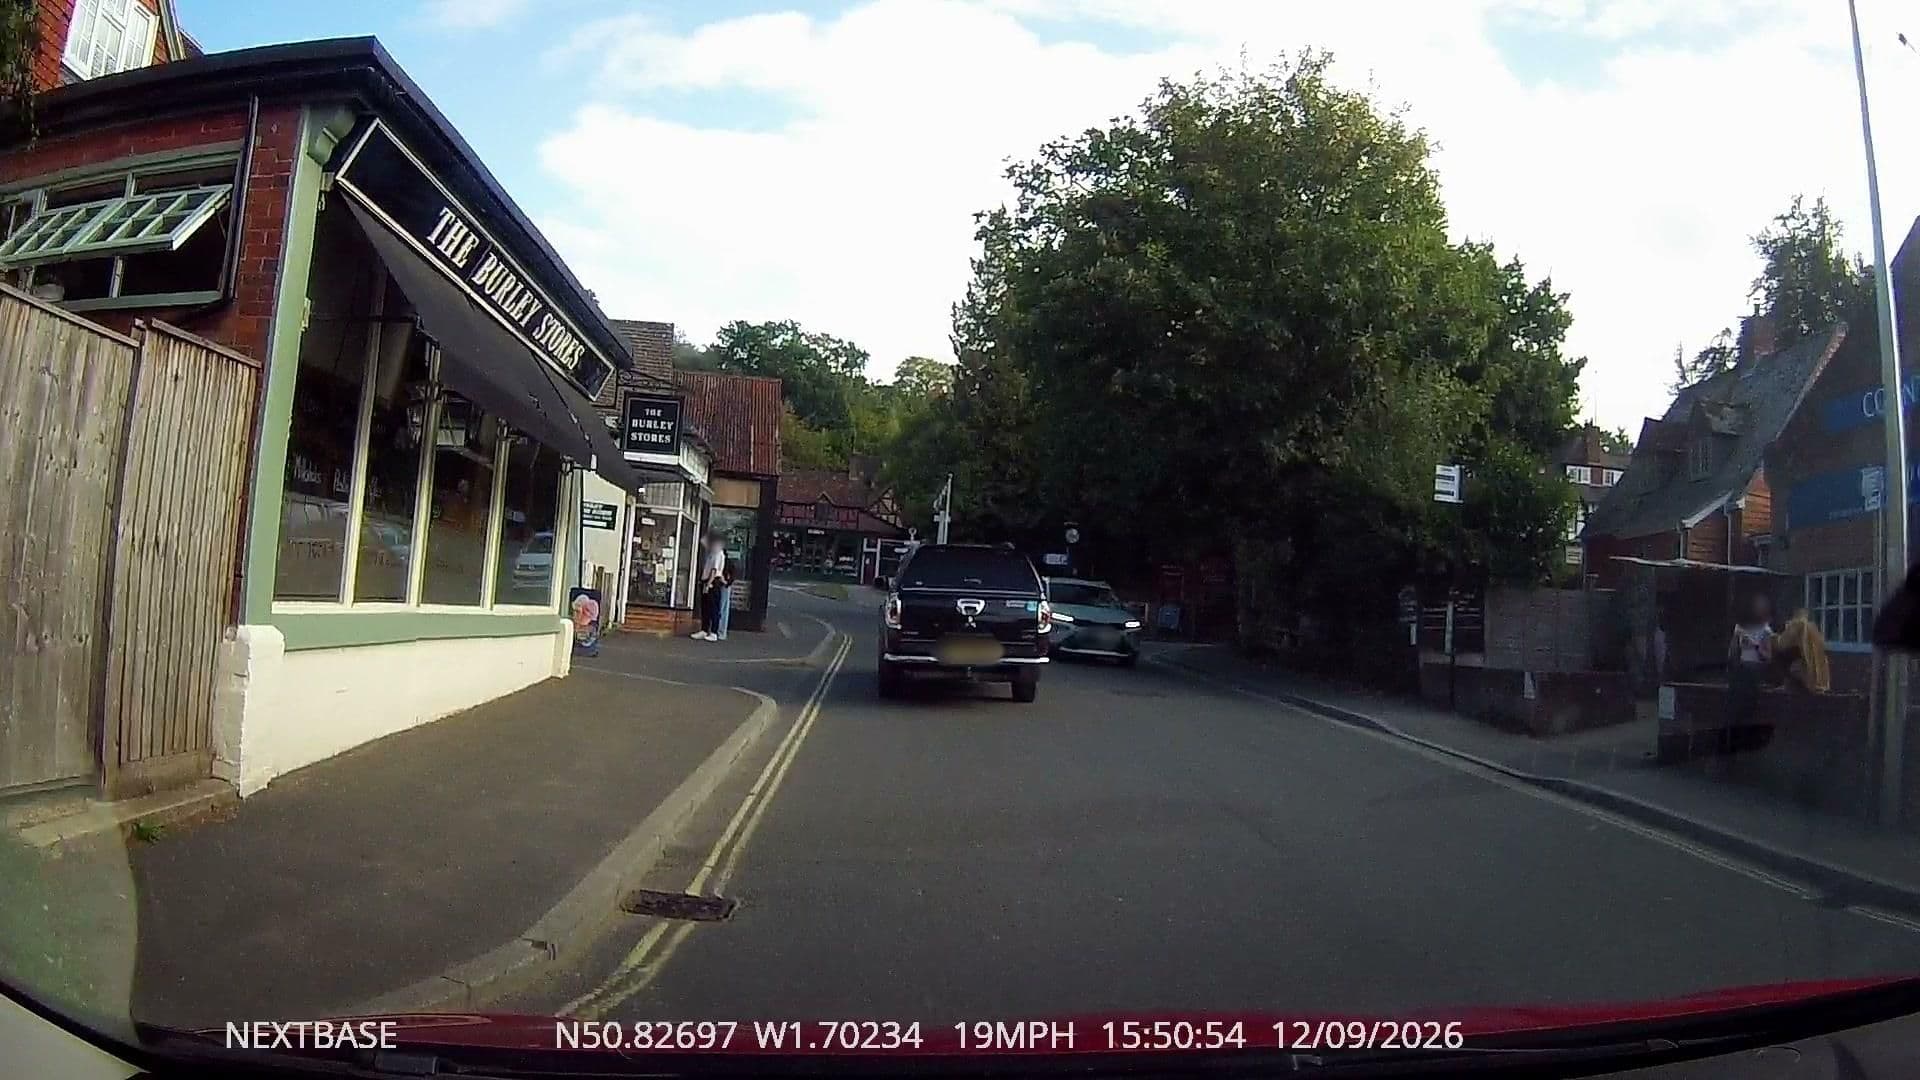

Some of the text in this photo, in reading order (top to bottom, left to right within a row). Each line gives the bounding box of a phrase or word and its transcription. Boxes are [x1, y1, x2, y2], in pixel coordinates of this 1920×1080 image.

[426, 206, 585, 370] THE BURLEY STORES
[644, 408, 662, 417] THE
[631, 418, 674, 431] BURLEY
[630, 431, 672, 444] STORES
